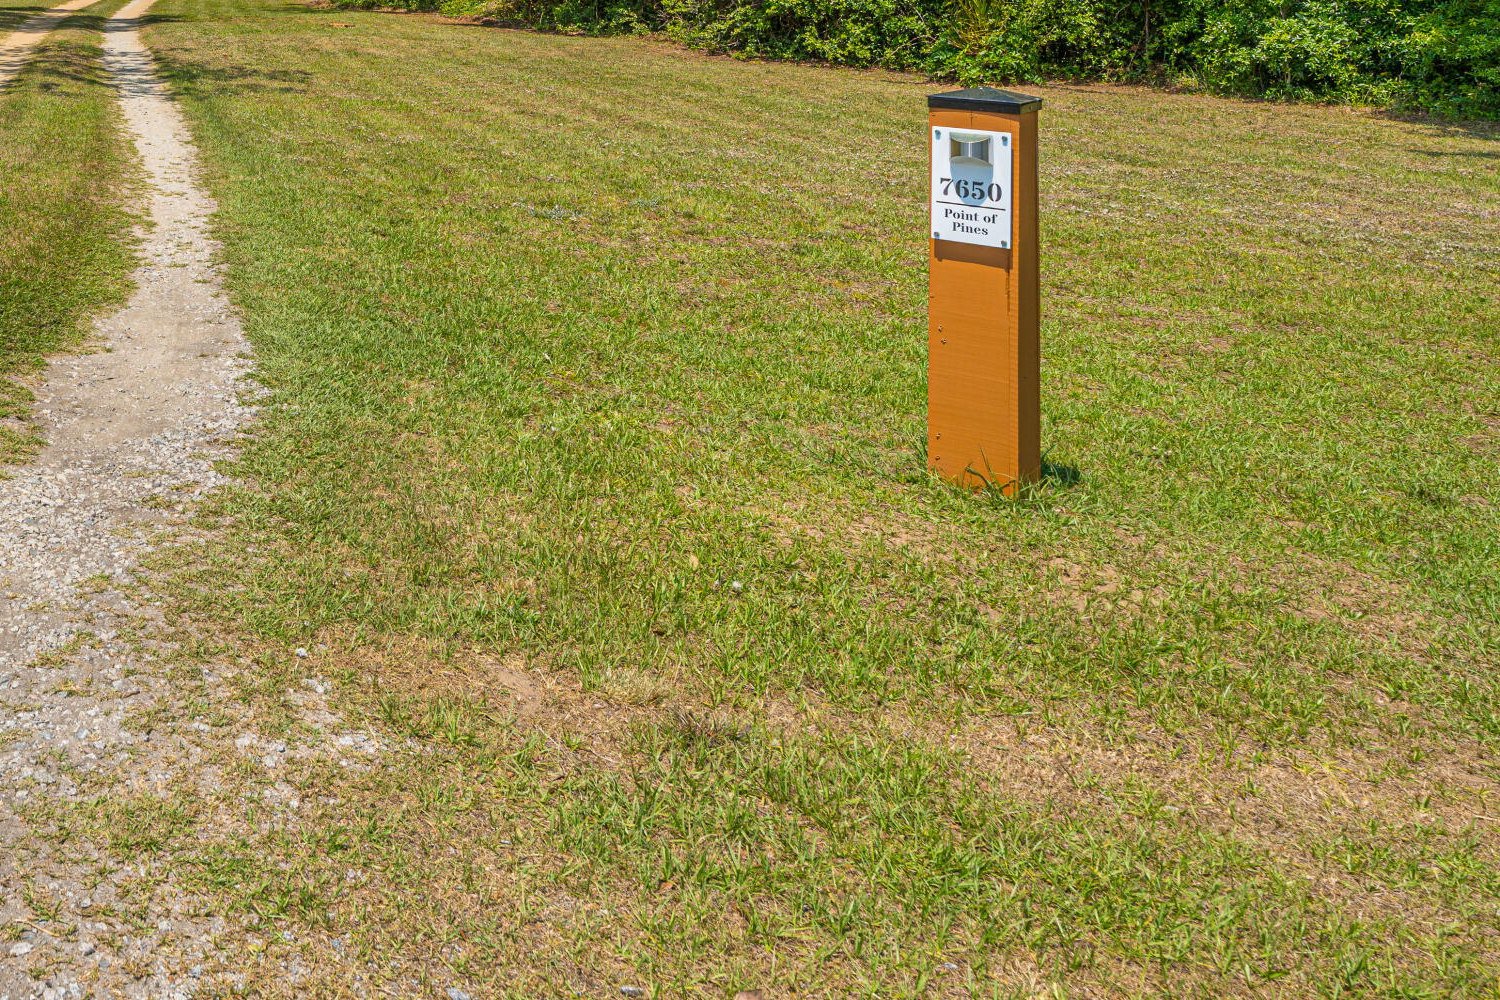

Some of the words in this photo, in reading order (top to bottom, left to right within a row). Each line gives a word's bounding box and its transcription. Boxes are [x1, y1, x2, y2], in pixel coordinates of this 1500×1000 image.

[940, 177, 1002, 202] 7650
[944, 208, 979, 222] Point
[983, 213, 998, 224] of
[952, 222, 989, 236] Pines
